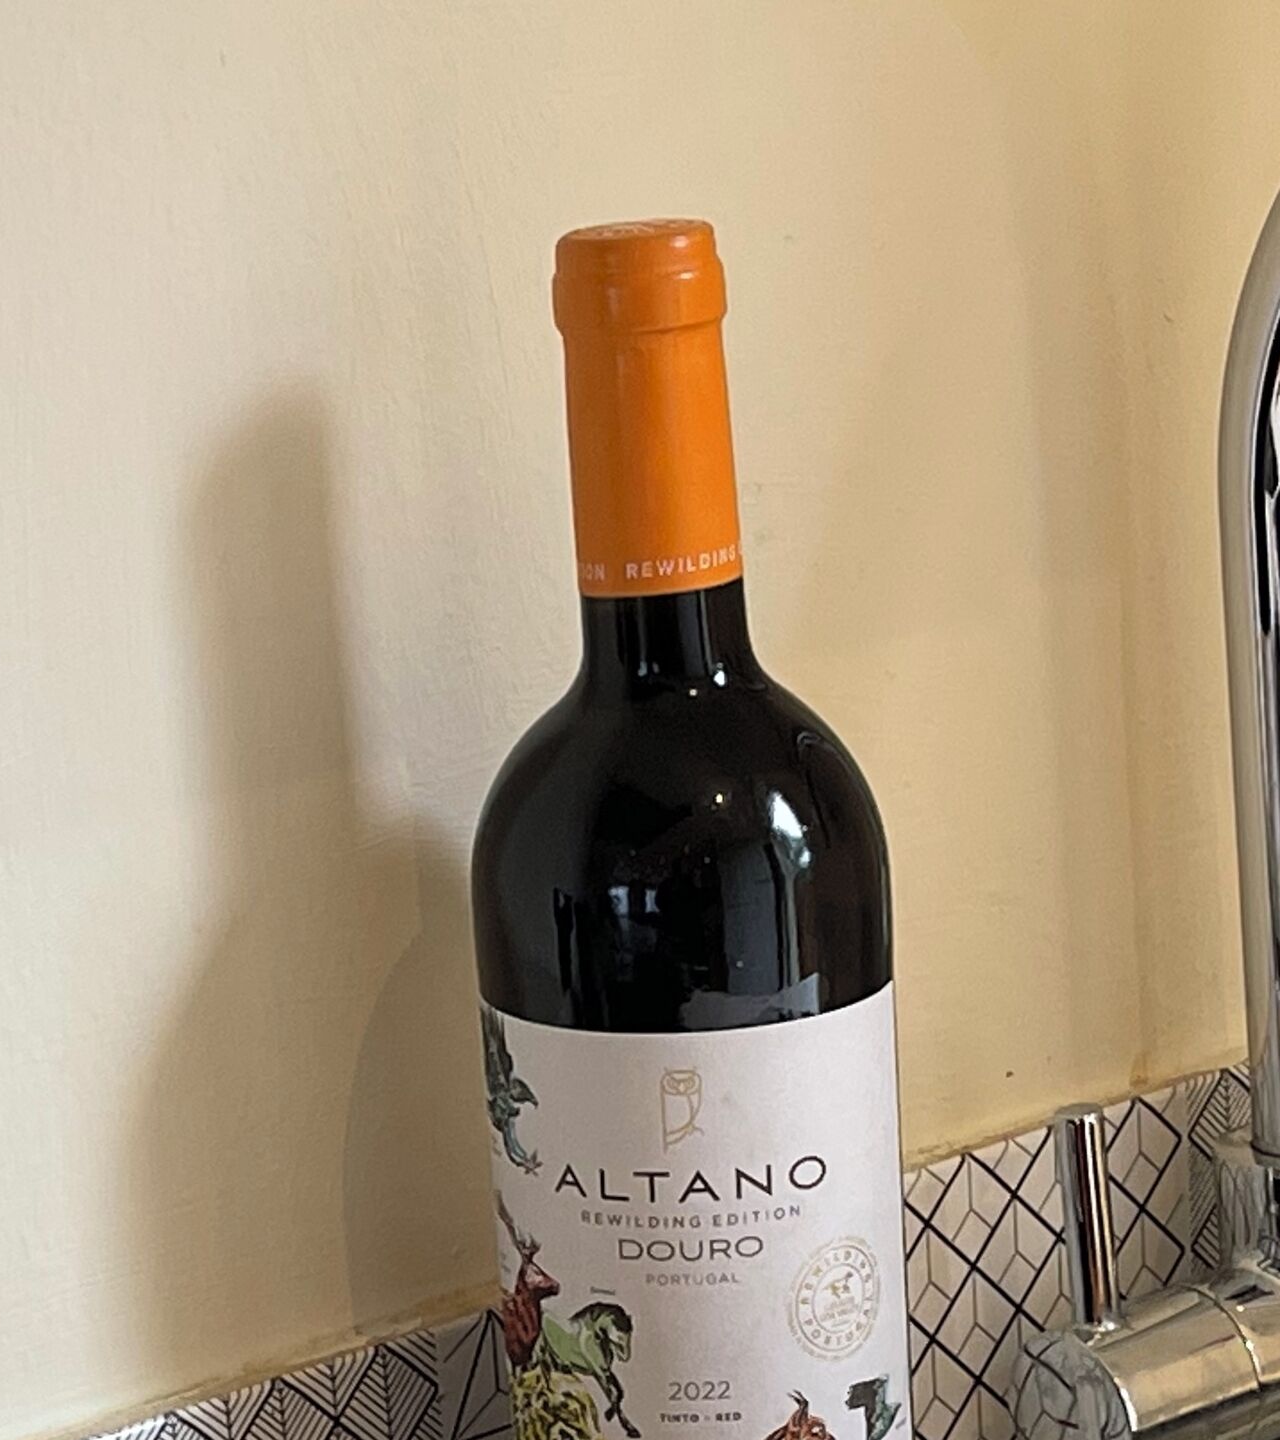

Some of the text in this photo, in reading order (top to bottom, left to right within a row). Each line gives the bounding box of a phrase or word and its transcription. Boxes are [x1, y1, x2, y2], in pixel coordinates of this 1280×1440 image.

[554, 1155, 827, 1203] ALTANO
[580, 1204, 802, 1229] REWILDING EDITION
[618, 1235, 764, 1262] DOURO
[645, 1272, 741, 1287] PORTUGAL
[668, 1381, 732, 1401] 2022
